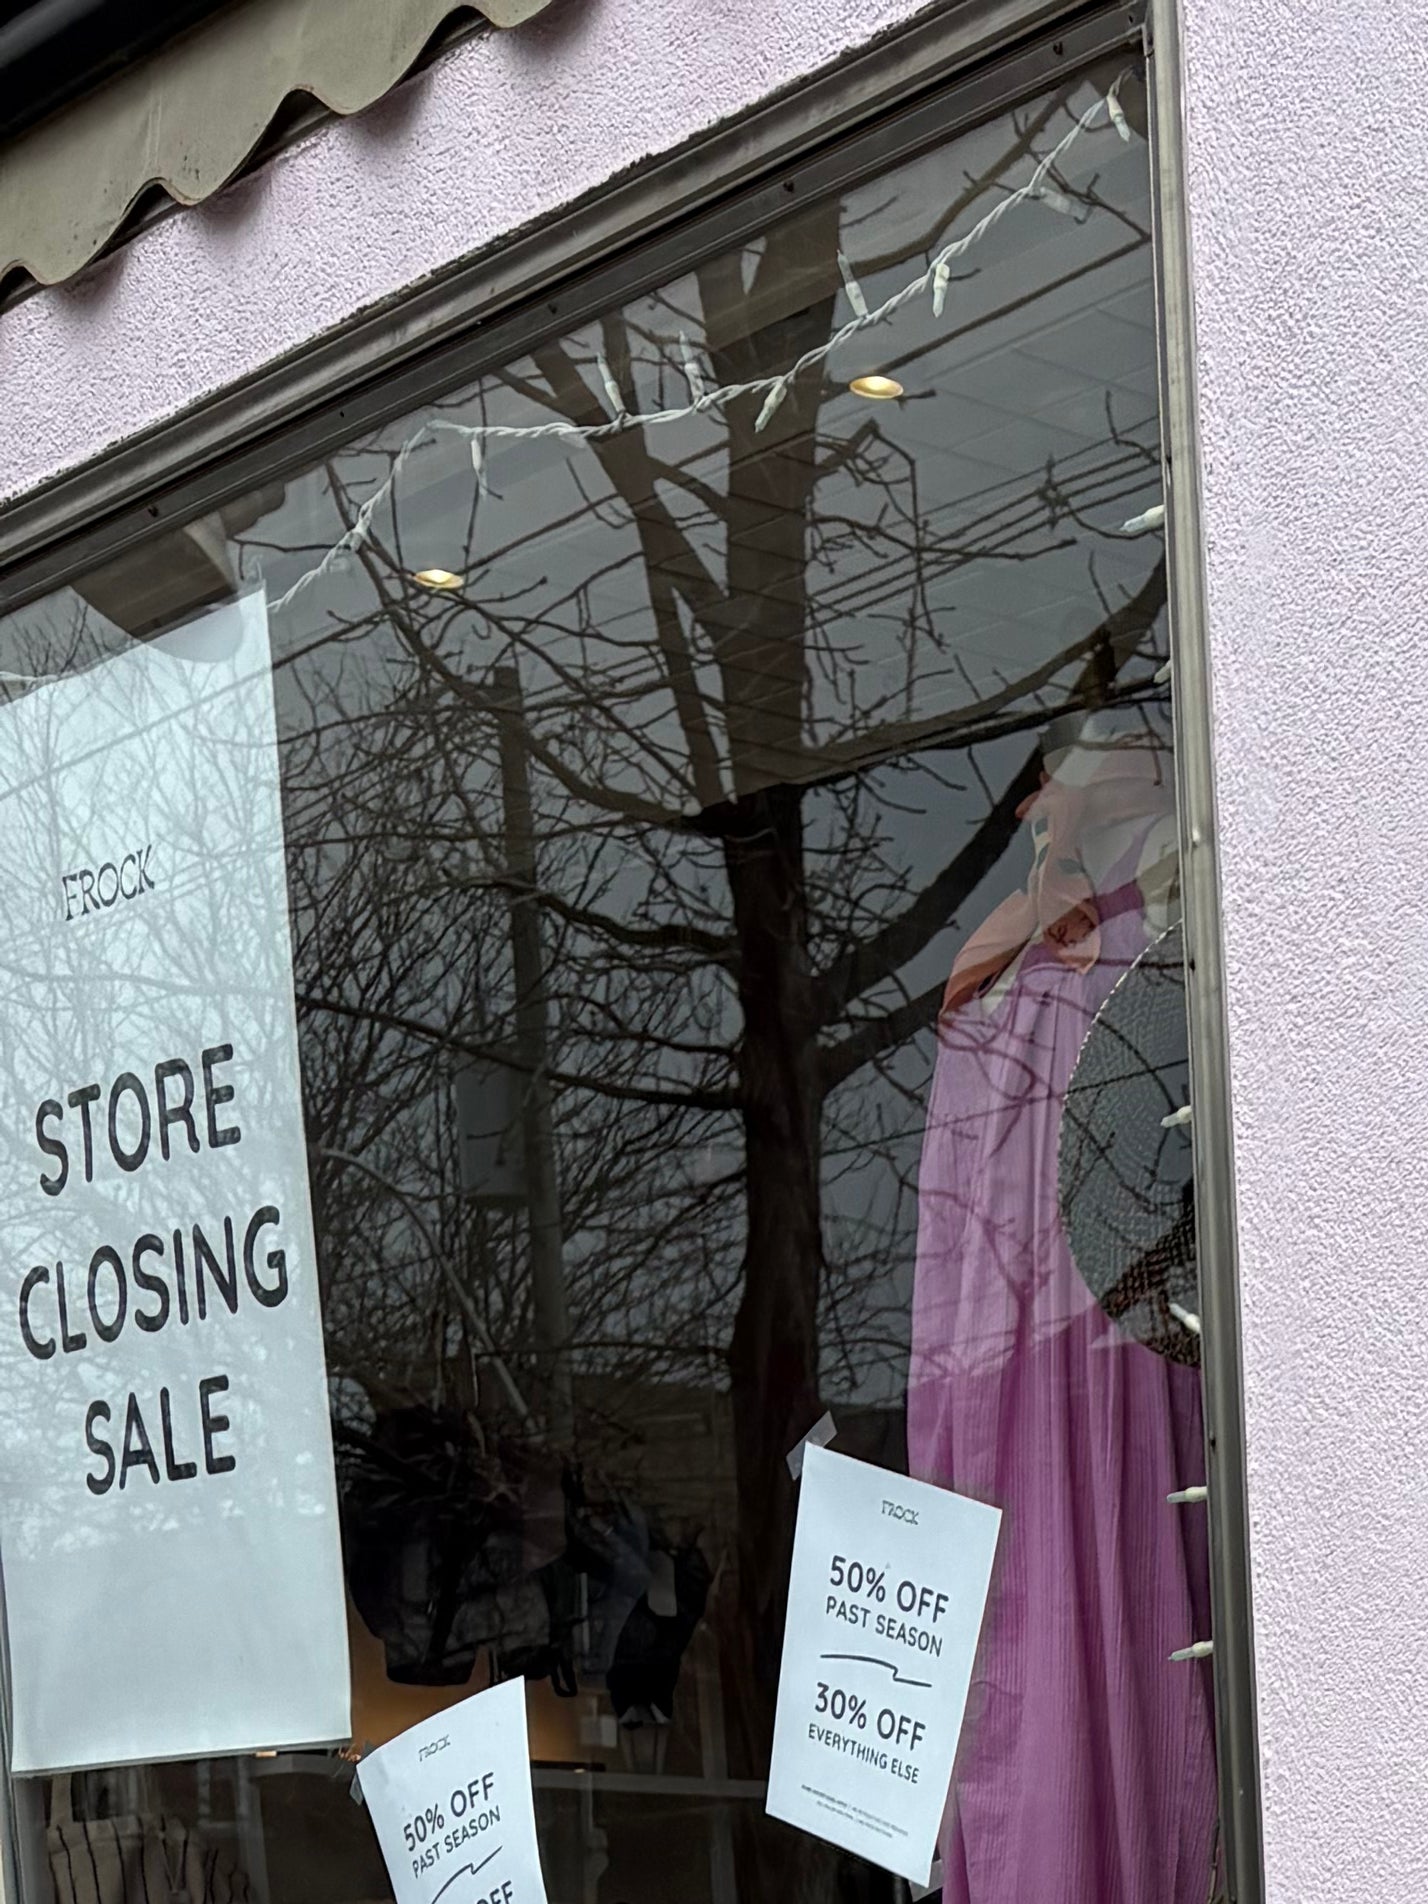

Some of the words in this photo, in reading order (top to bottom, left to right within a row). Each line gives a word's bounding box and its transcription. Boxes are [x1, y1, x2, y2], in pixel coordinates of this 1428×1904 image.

[62, 844, 155, 921] FROCK
[36, 1043, 243, 1197] STORE
[18, 1205, 291, 1362] CLOSING
[85, 1375, 237, 1497] SALE
[826, 1595, 871, 1628] PAST
[875, 1614, 943, 1658] SEASON
[829, 1555, 886, 1603] 50%
[896, 1580, 950, 1624] OFF
[808, 1722, 888, 1771] EVERYTHING
[891, 1757, 920, 1784] ELSE
[814, 1681, 867, 1730] 30%
[877, 1708, 927, 1751] OFF
[402, 1803, 445, 1852] 50%
[450, 1771, 495, 1818] OFF
[411, 1842, 441, 1879] PAST
[446, 1805, 501, 1854] SEASON
